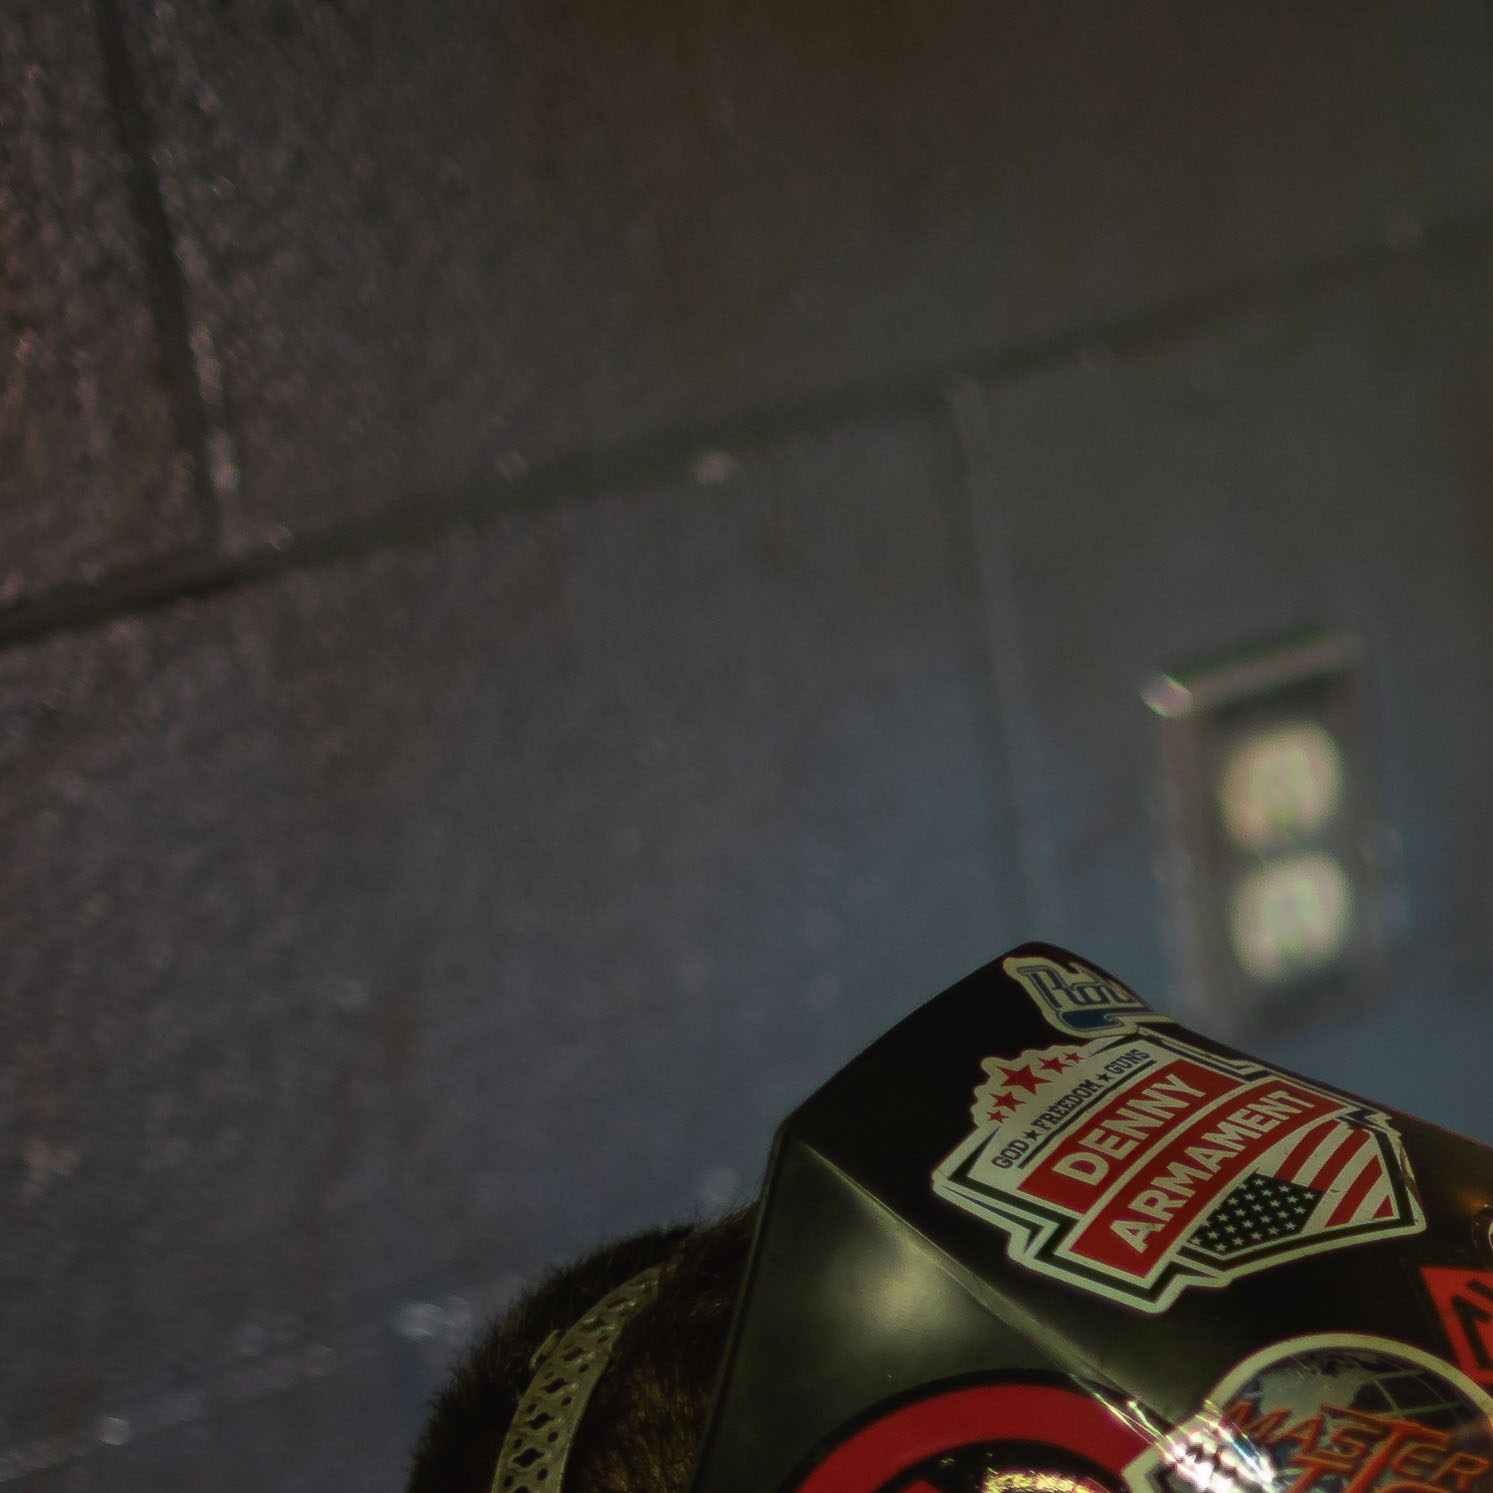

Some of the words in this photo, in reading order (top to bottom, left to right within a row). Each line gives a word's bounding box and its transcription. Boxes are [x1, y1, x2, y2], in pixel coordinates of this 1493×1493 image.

[991, 1139, 1030, 1169] GOD
[1031, 1079, 1102, 1131] FREEDOM
[1104, 1048, 1151, 1075] GUNS
[1051, 1072, 1208, 1187] DENNY
[1109, 1088, 1316, 1254] ARMAMENT
